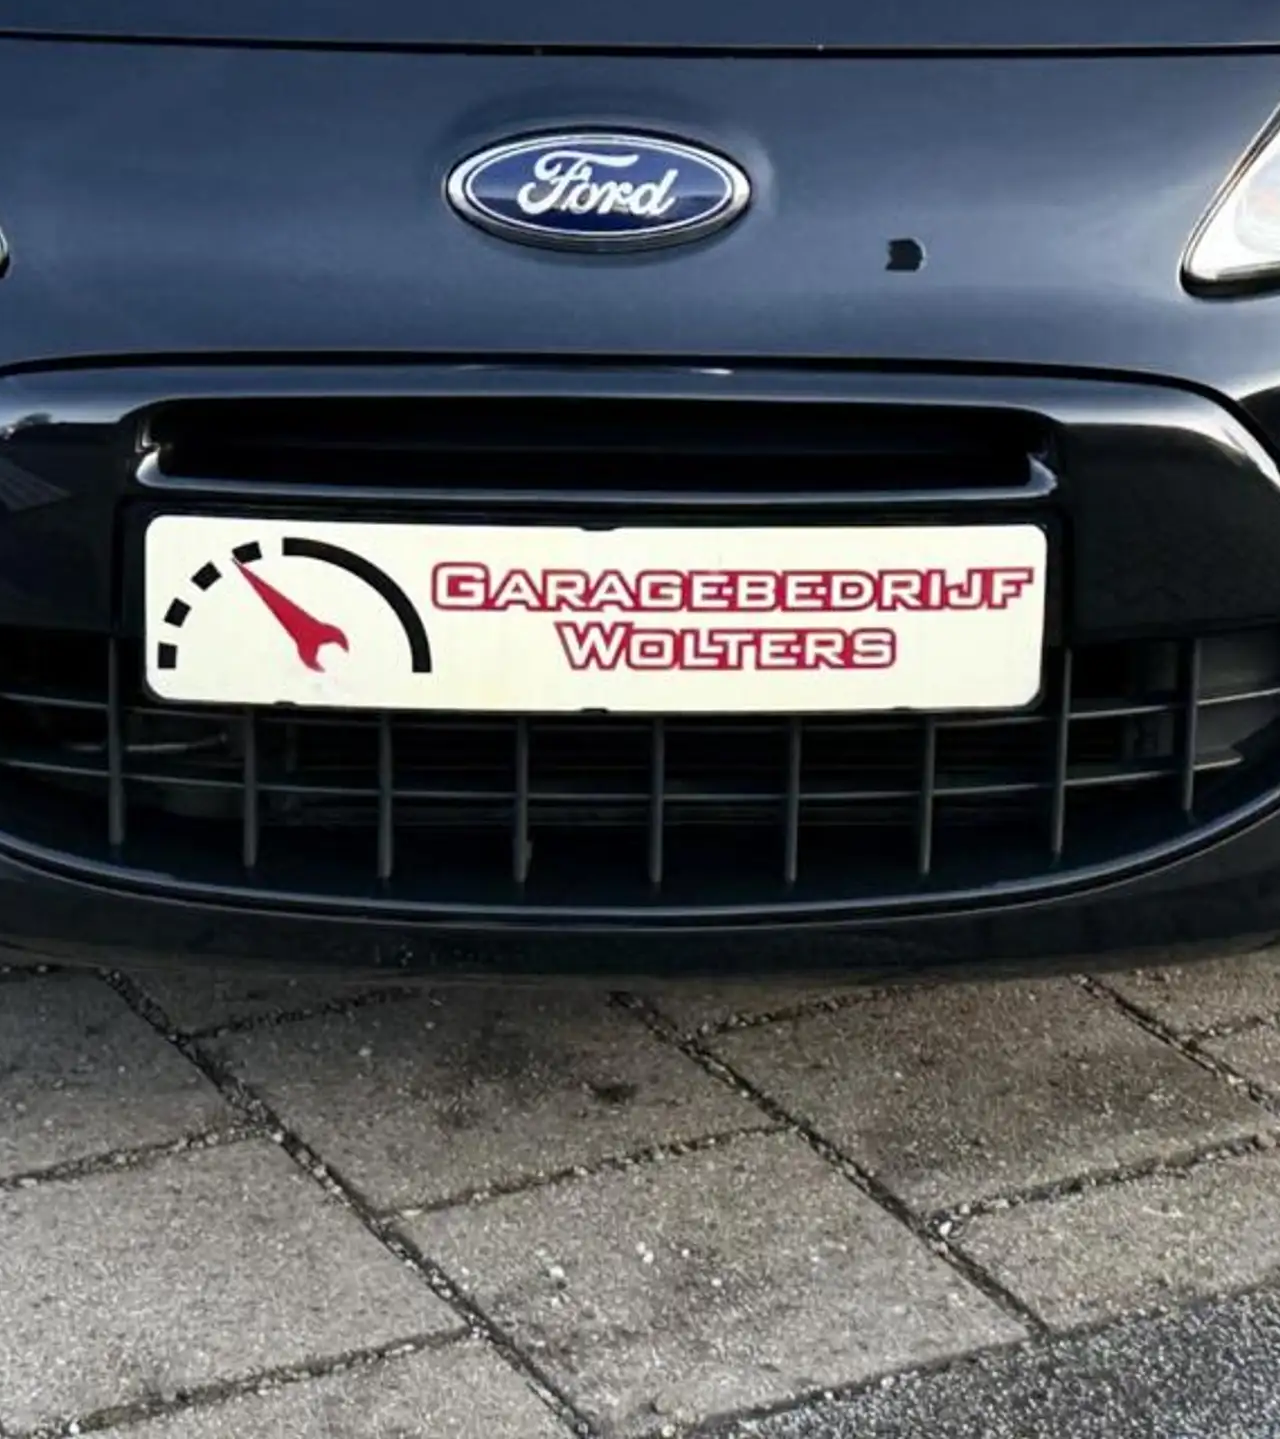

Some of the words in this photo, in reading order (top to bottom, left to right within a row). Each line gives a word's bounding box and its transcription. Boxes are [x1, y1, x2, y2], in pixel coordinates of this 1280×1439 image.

[517, 150, 679, 216] Ford
[431, 561, 1035, 611] GARAGEBEDRIJF
[554, 620, 898, 670] WOLTERS
